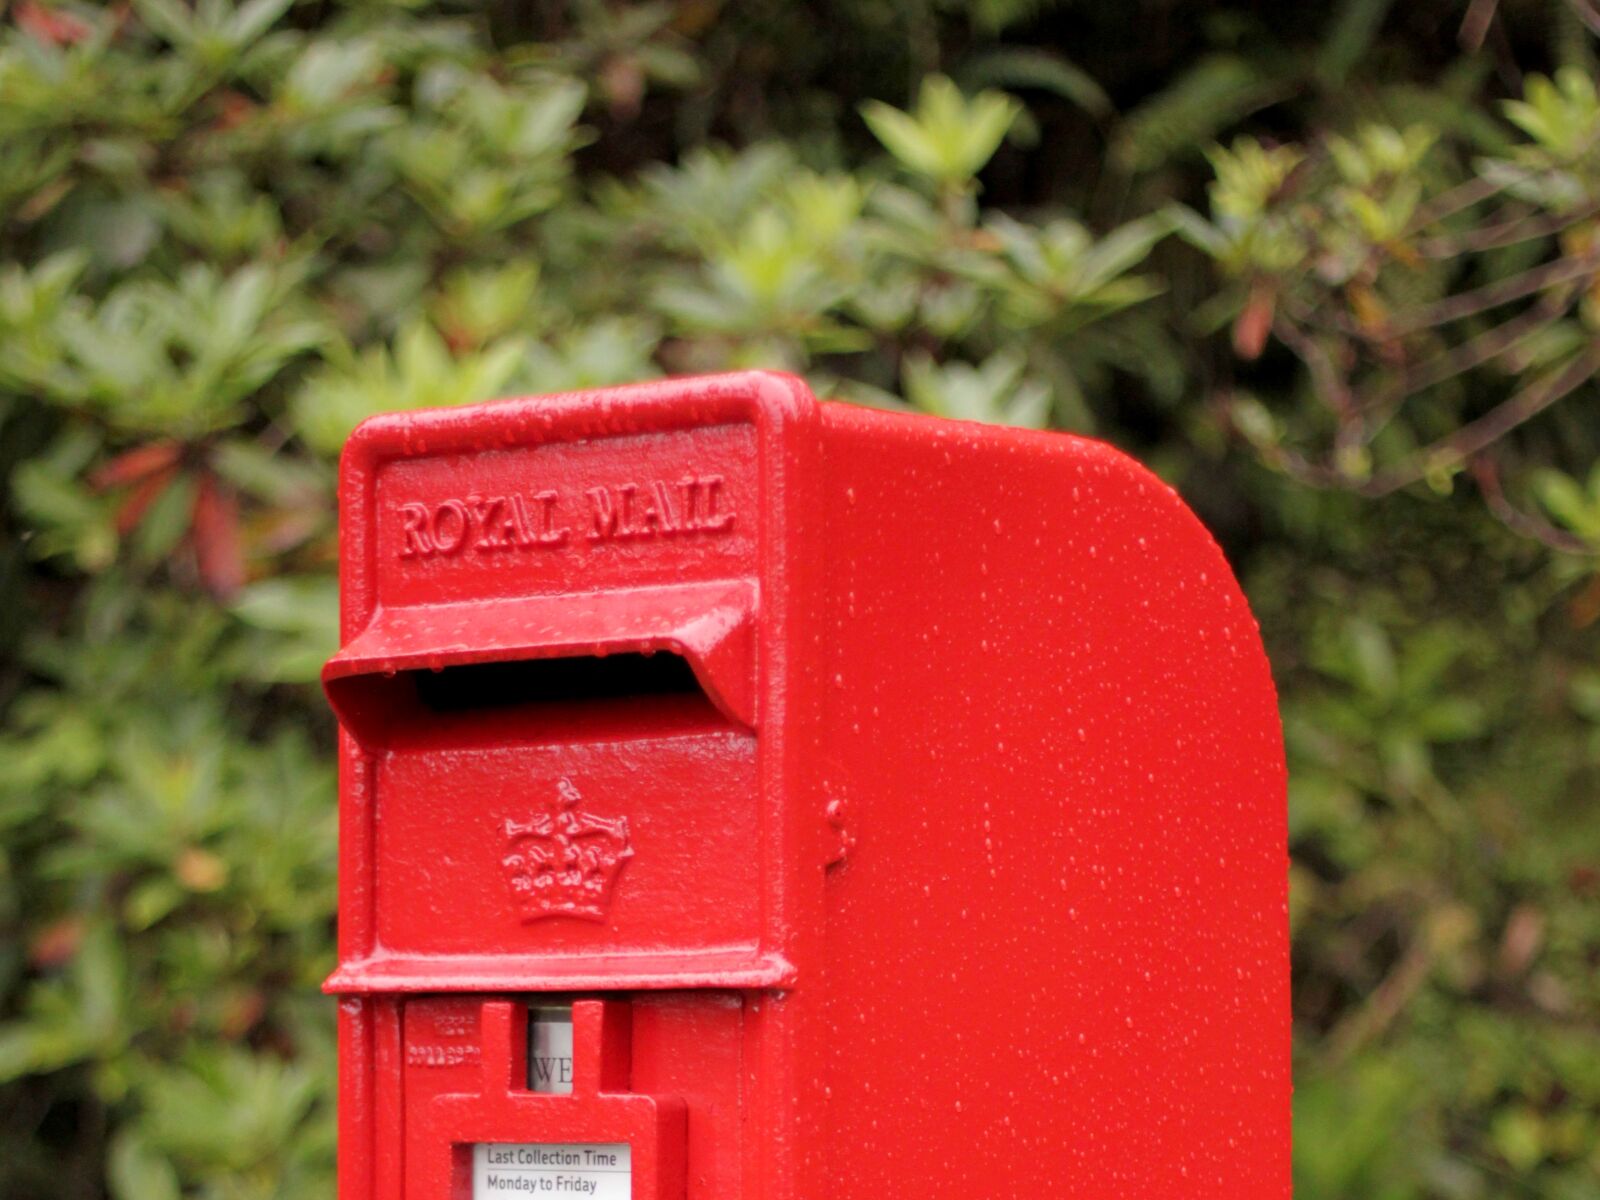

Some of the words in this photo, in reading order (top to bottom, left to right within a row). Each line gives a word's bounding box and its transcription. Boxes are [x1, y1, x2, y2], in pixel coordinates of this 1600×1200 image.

[399, 489, 569, 558] ROYAL
[587, 474, 736, 544] MAIL
[487, 1149, 514, 1165] Last
[517, 1149, 580, 1166] Collection
[584, 1150, 617, 1166] Time
[487, 1175, 537, 1194] Monday
[540, 1177, 553, 1191] to
[556, 1175, 597, 1195] Friday
